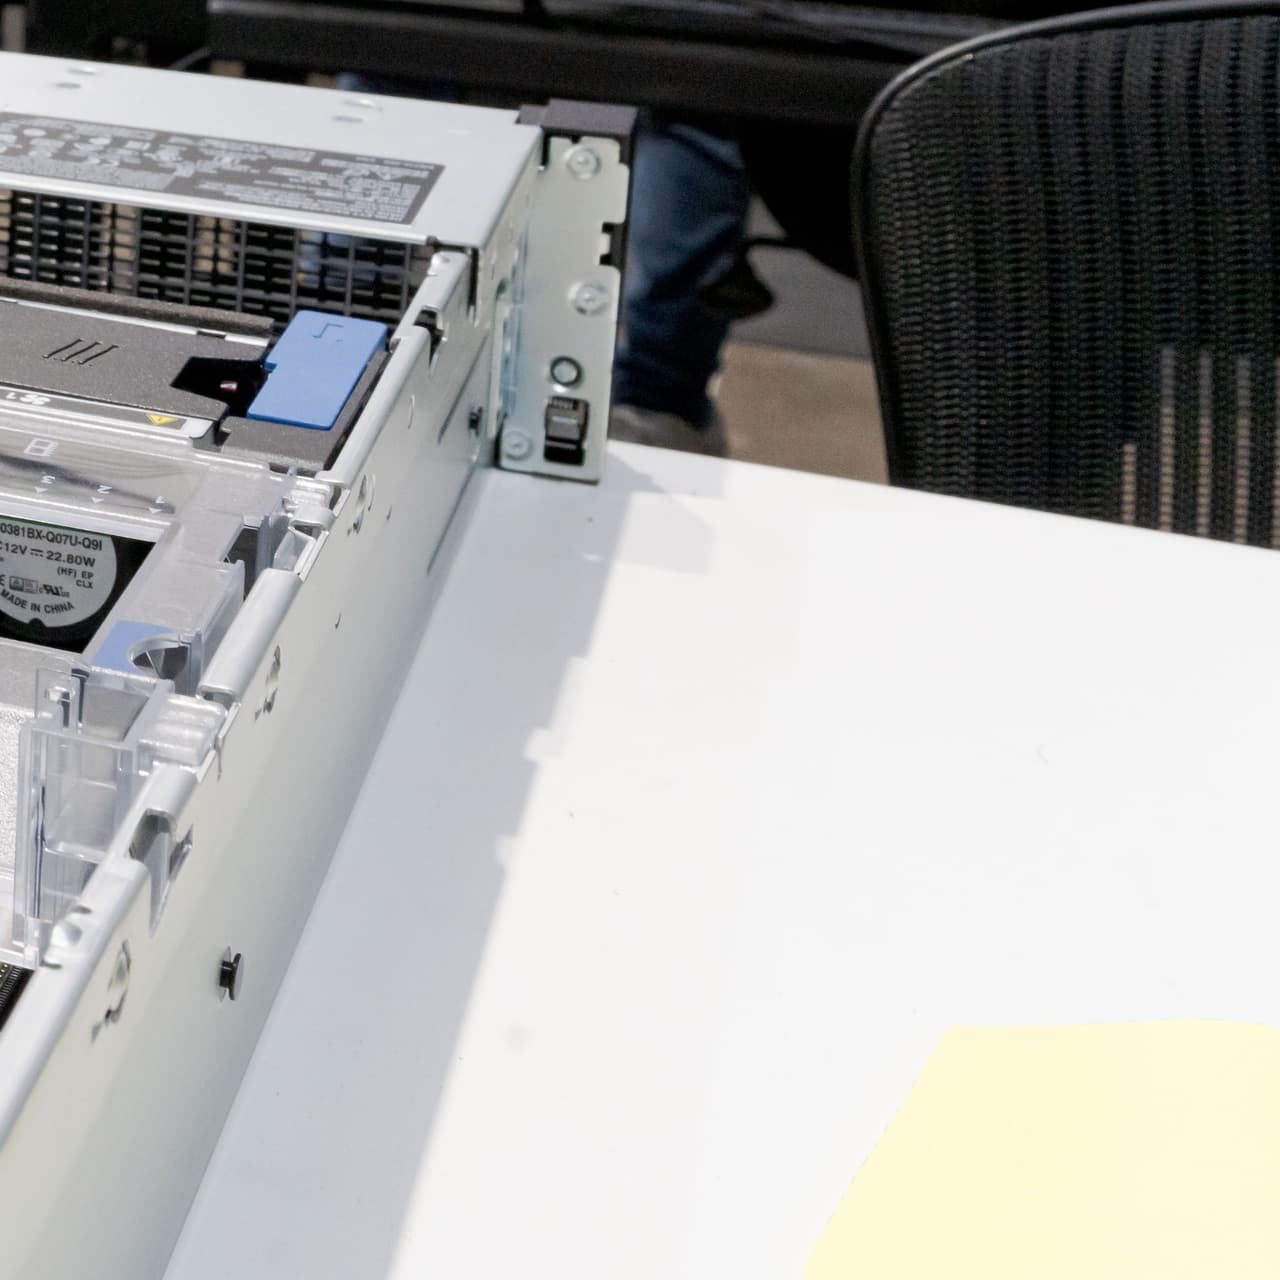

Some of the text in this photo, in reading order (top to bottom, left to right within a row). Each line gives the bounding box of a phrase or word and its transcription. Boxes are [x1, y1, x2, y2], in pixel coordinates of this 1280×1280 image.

[46, 550, 96, 568] 22.80W
[0, 589, 75, 614] MADE IN CHINA
